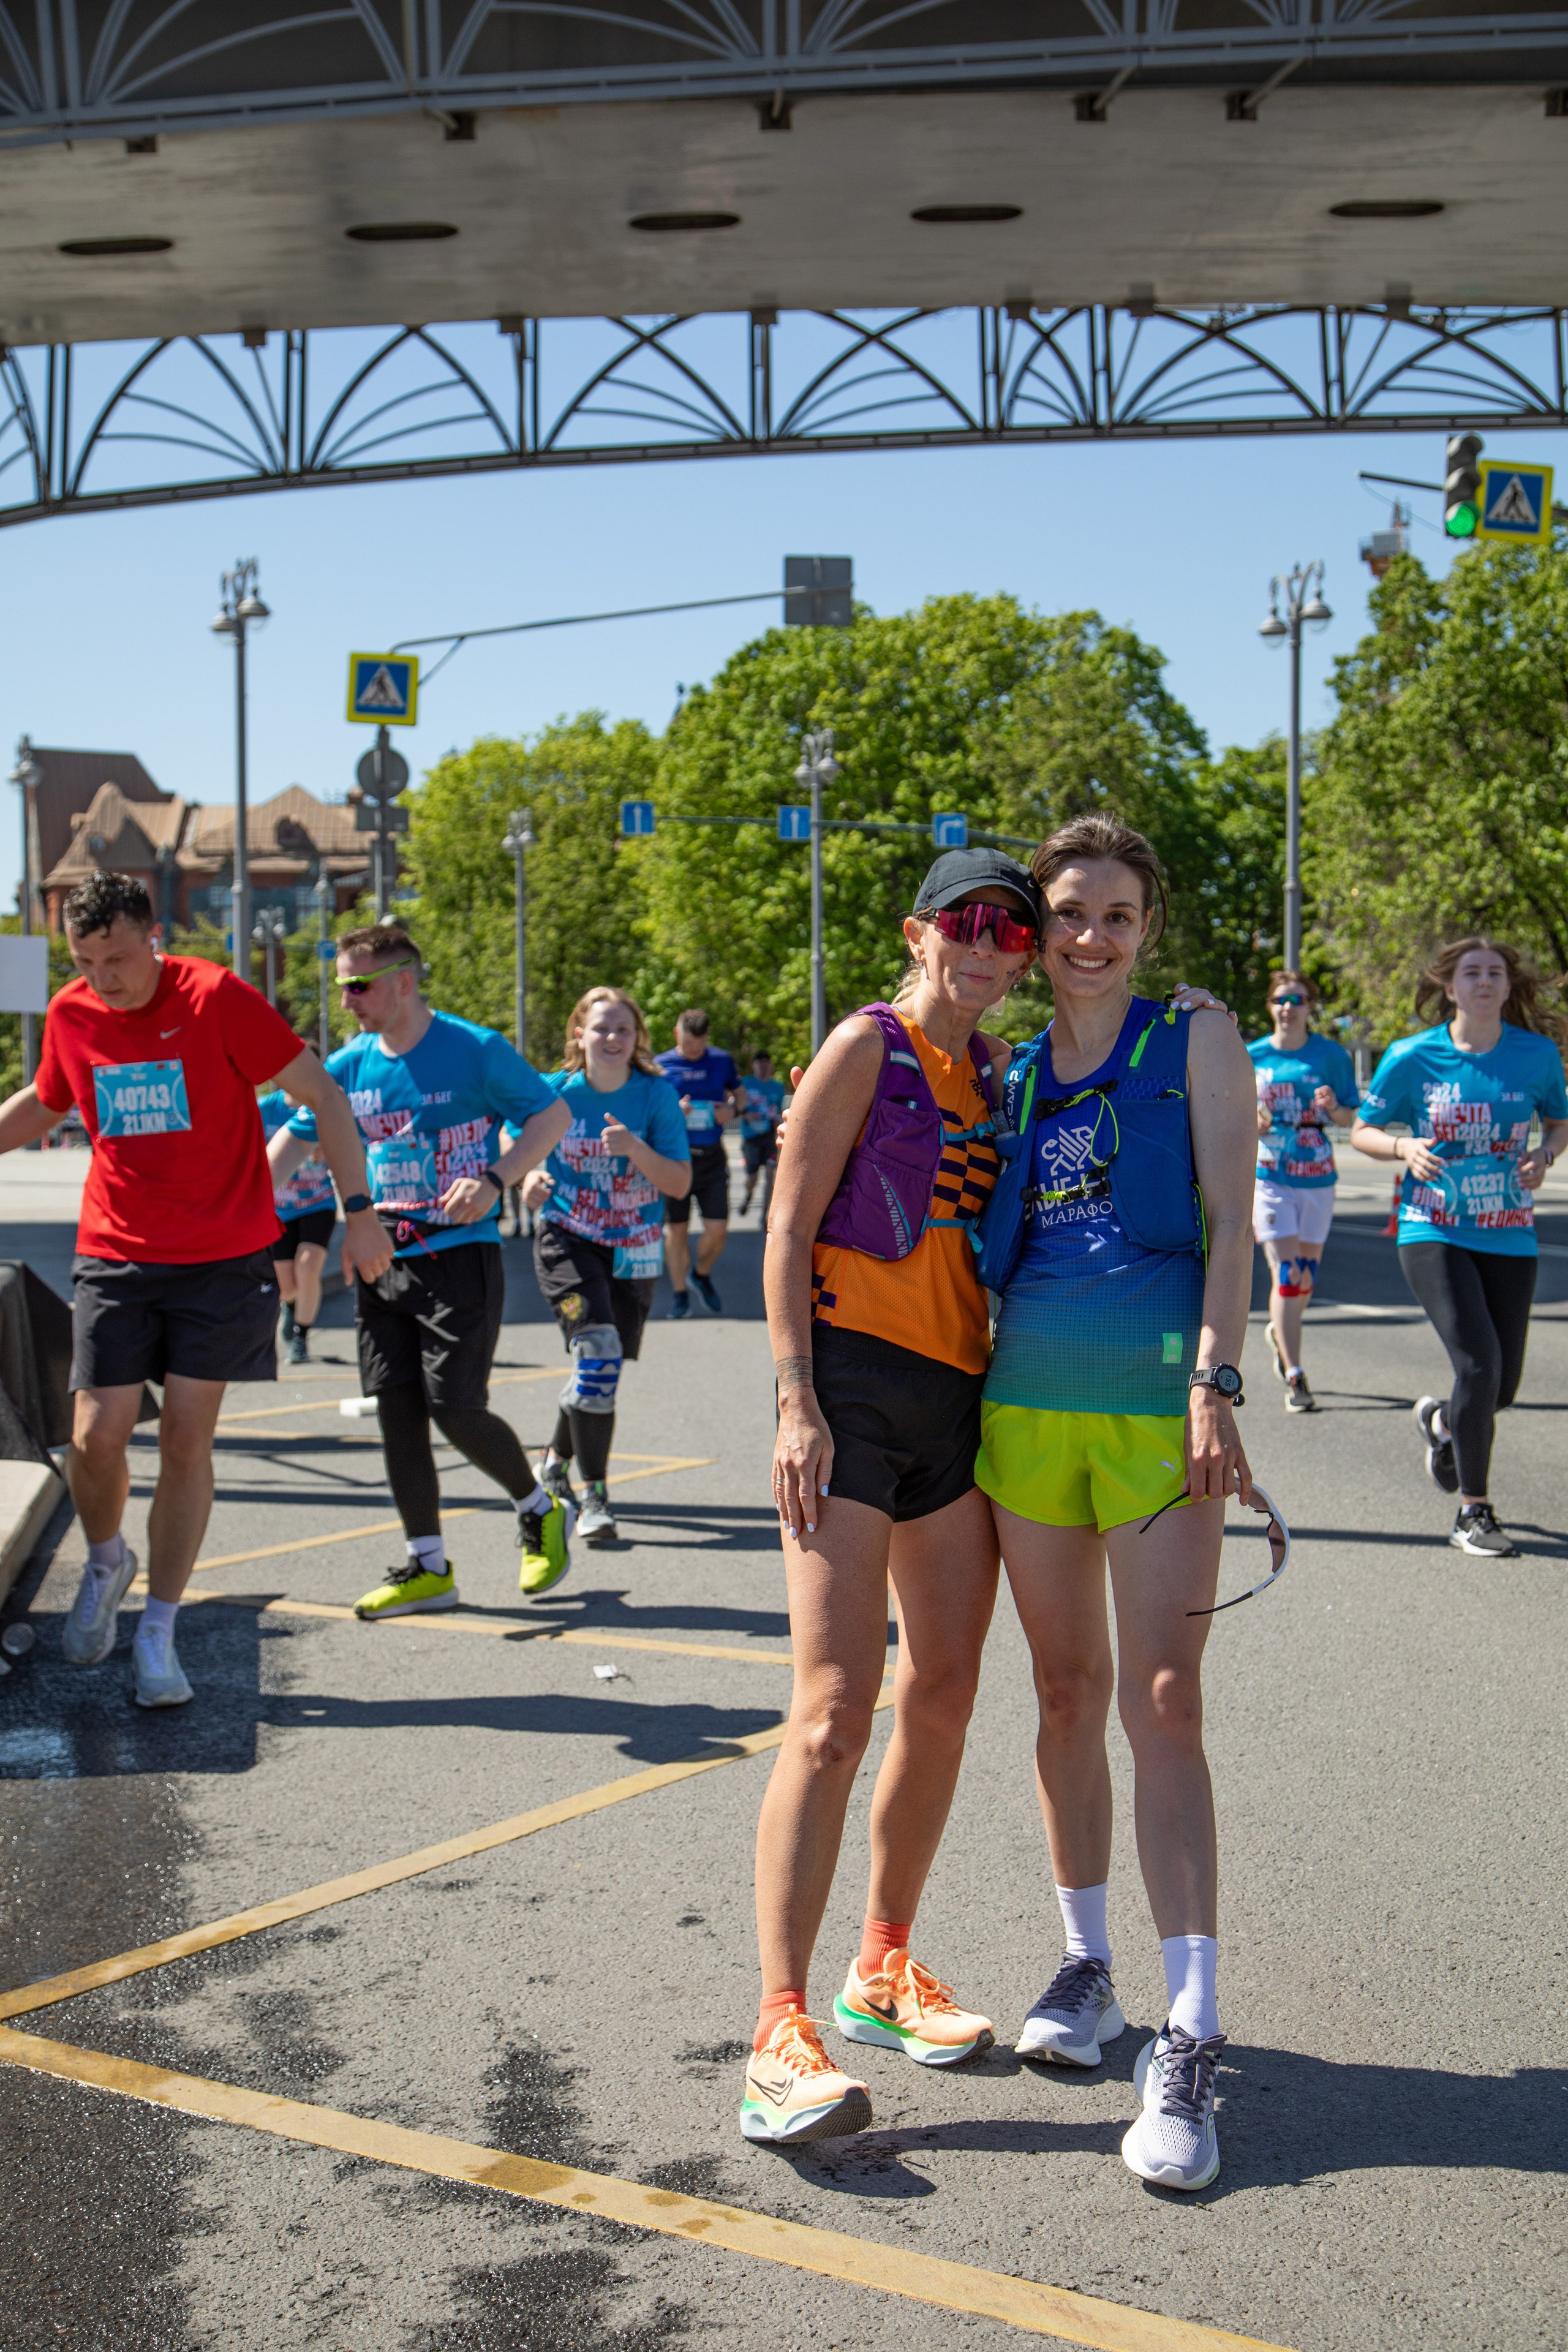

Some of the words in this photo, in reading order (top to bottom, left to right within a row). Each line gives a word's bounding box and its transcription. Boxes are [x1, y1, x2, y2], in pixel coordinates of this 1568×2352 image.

[113, 1083, 171, 1114] 40743
[1007, 1069, 1020, 1116] CAMP
[1422, 1082, 1462, 1103] 2024
[376, 1160, 421, 1185] 42548
[1460, 1172, 1506, 1196] 41237
[1041, 1200, 1115, 1229] МАРАФО
